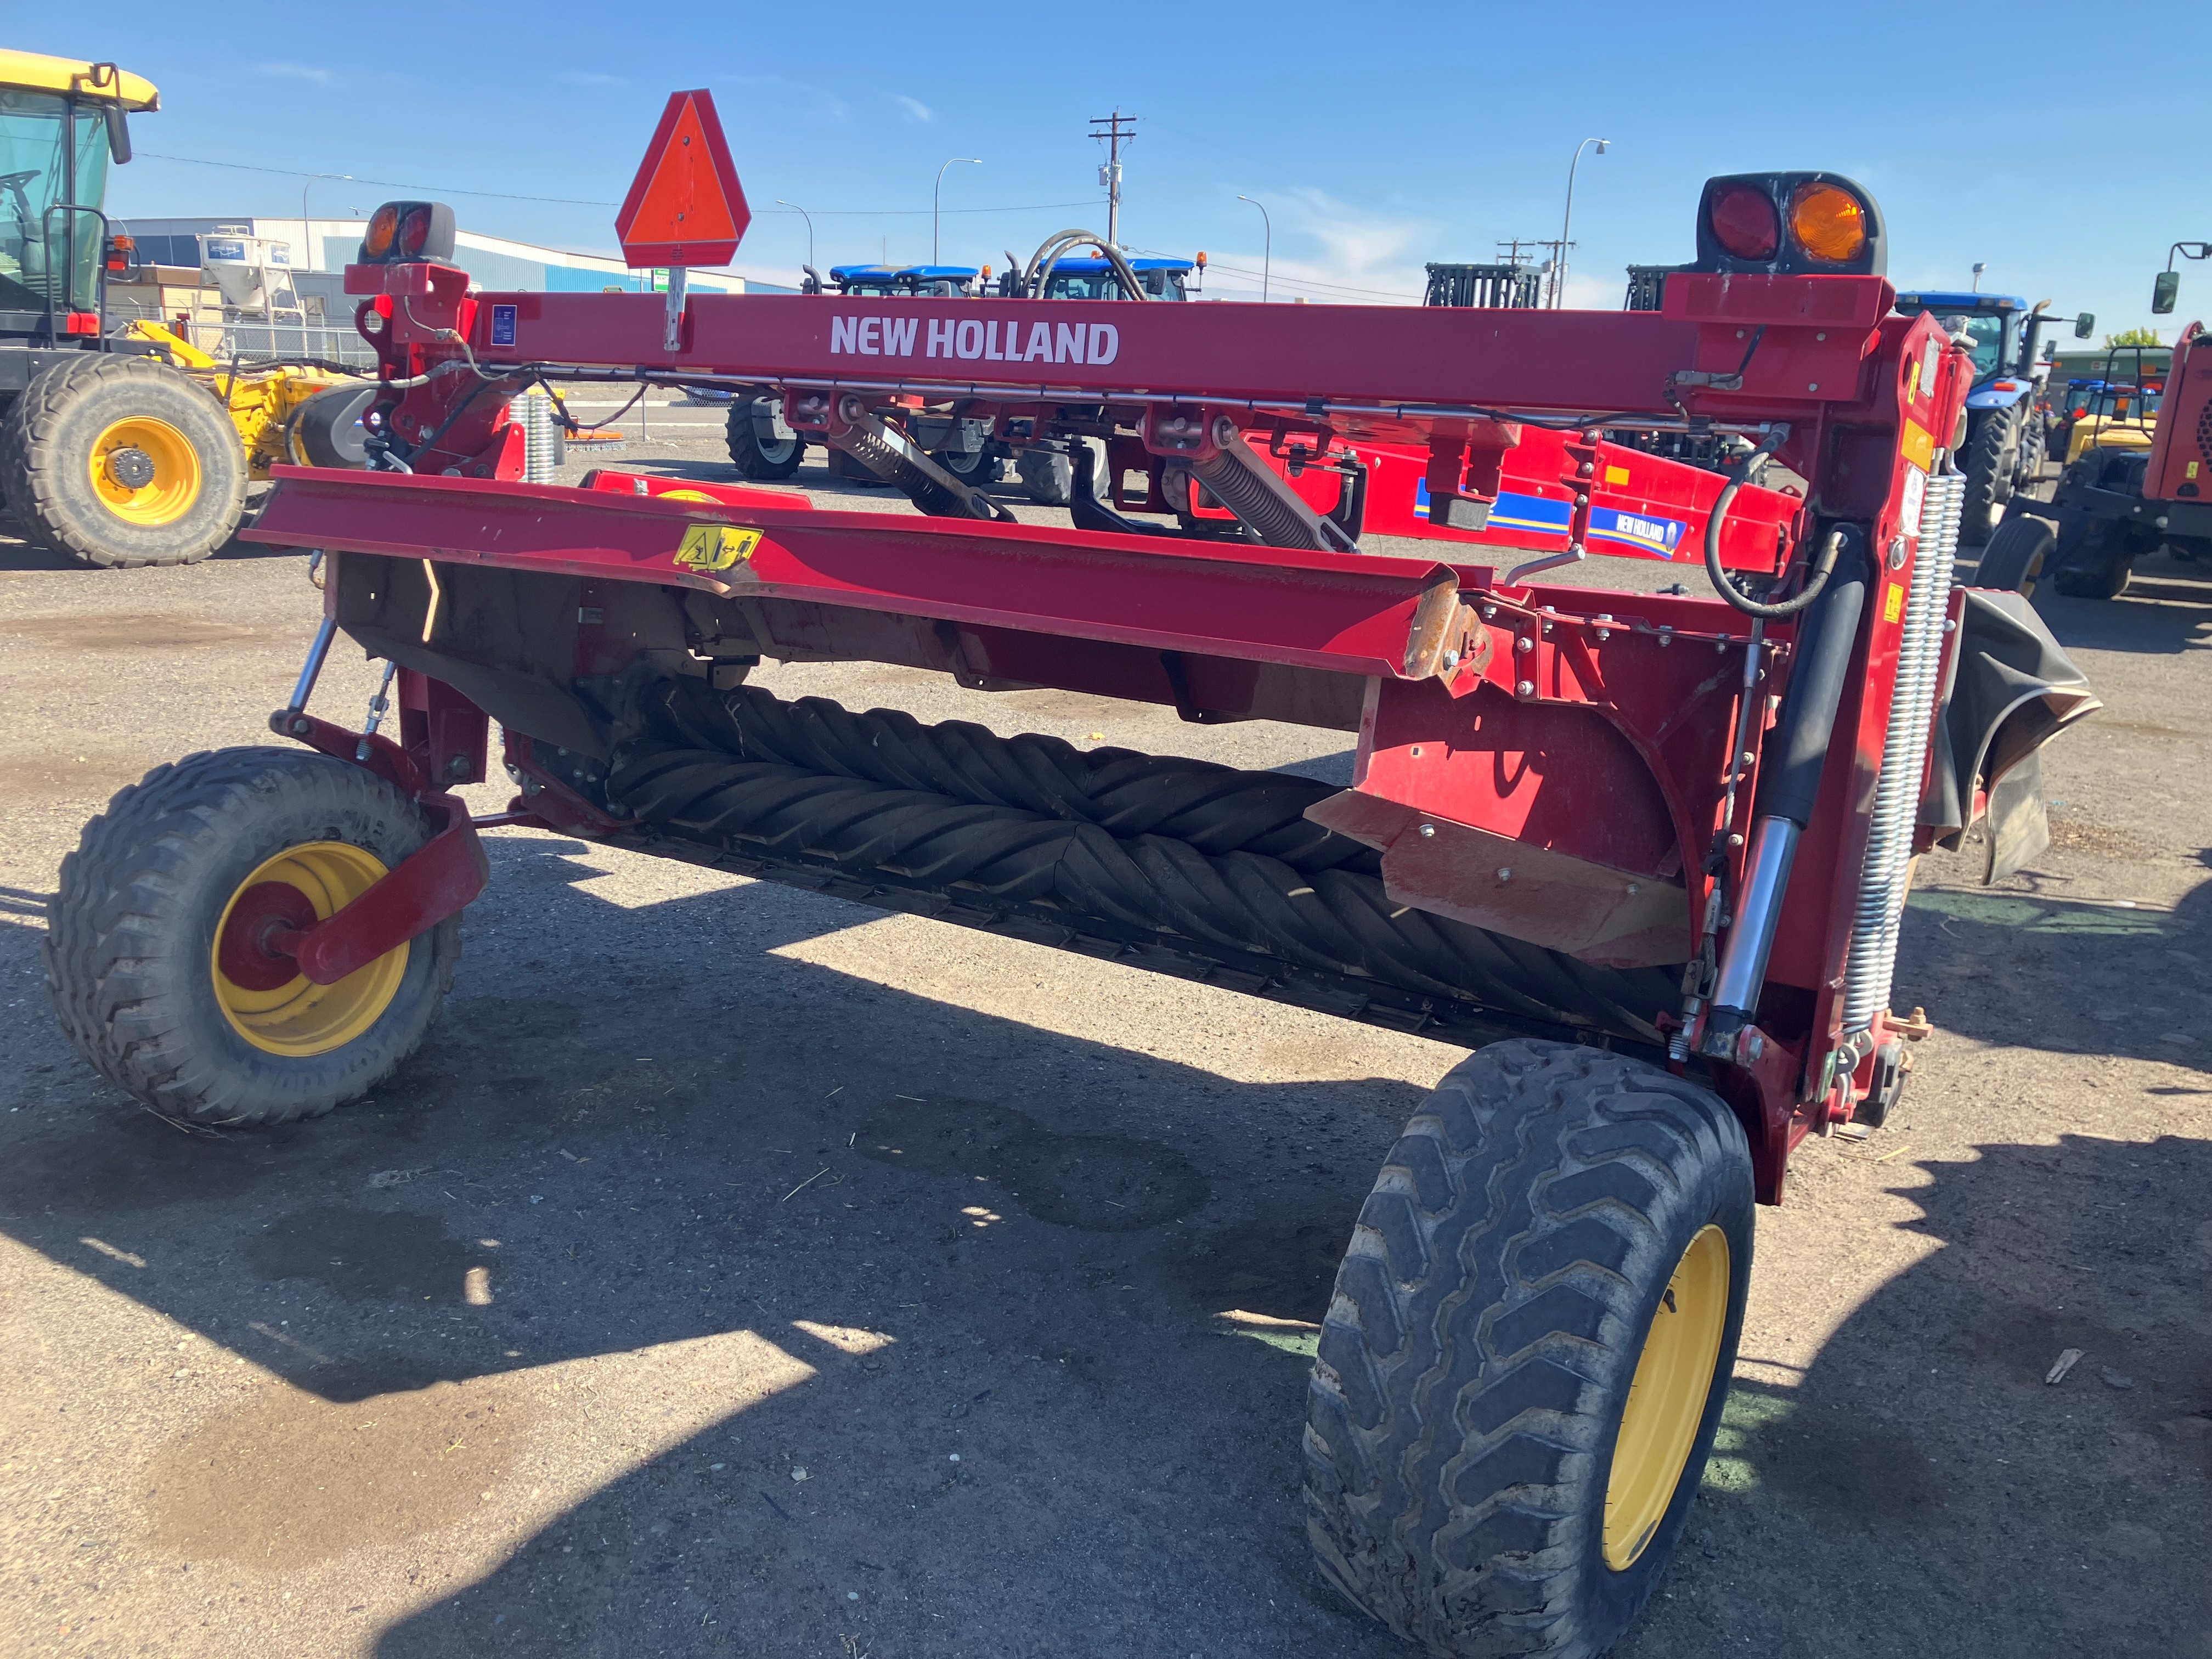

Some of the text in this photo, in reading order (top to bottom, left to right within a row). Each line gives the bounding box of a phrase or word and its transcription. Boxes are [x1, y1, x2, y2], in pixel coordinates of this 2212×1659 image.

[831, 316, 1119, 365] NEW HOLLAND
[1617, 514, 1664, 542] NEW HOLLAND
